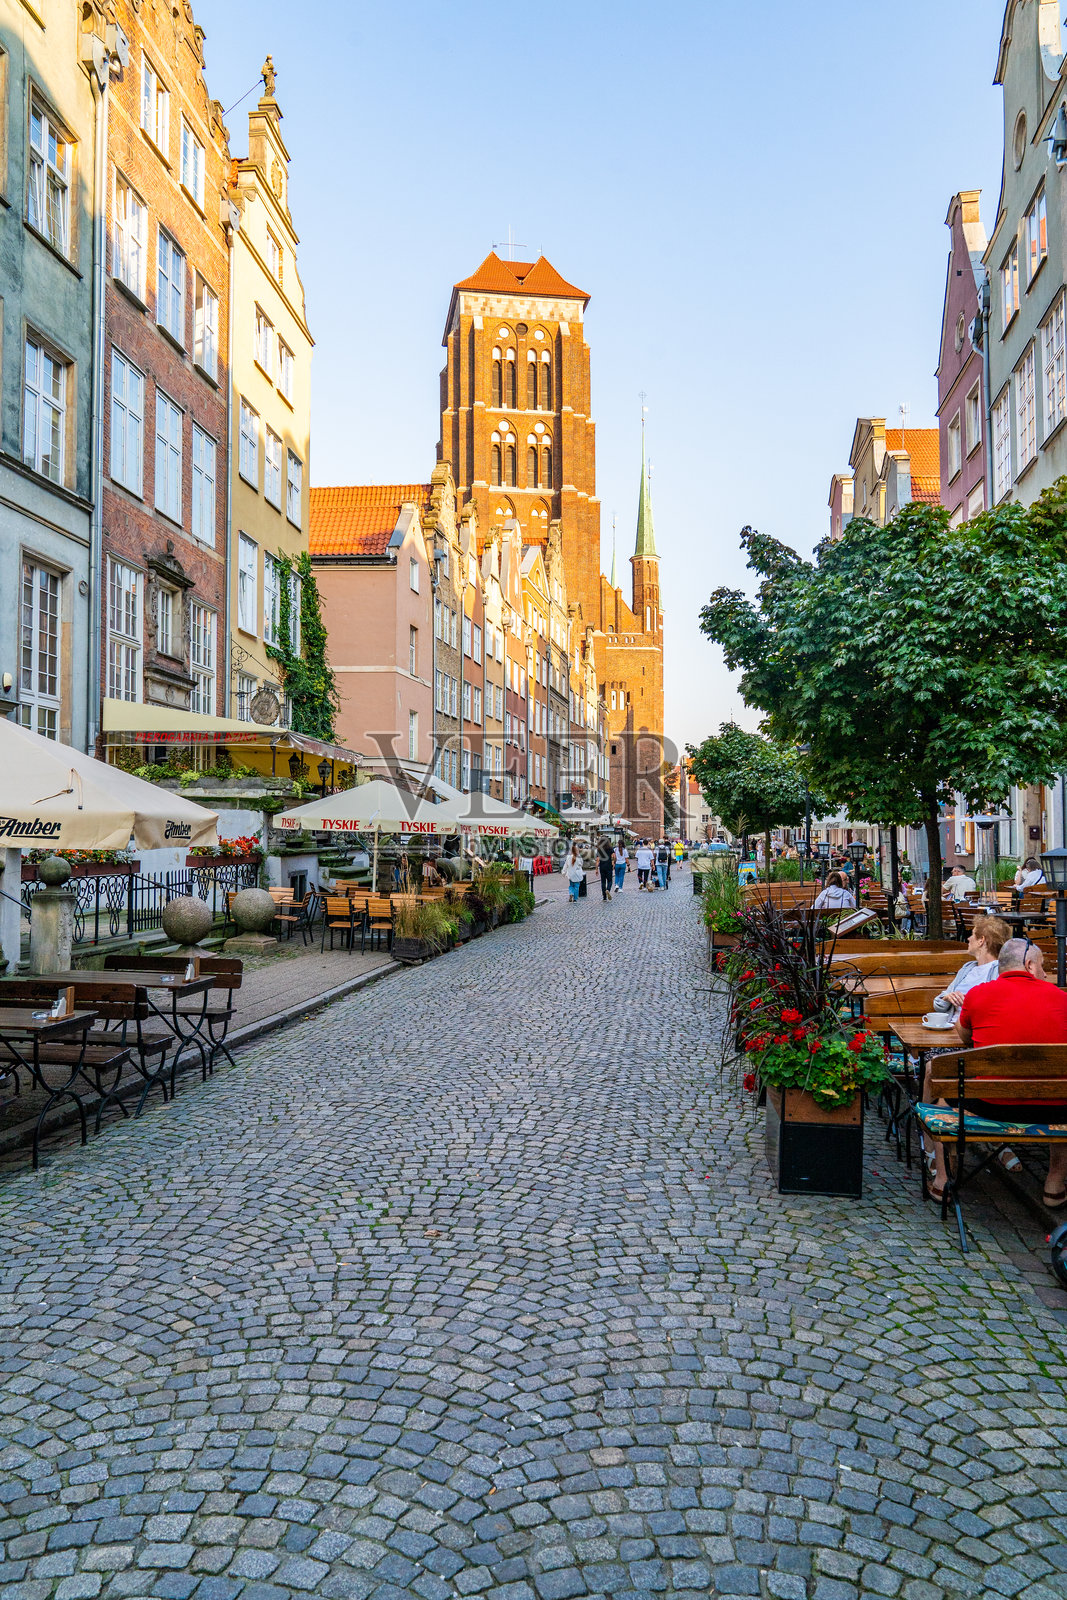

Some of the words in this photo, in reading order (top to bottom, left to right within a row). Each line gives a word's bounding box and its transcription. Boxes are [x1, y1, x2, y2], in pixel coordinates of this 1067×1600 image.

[135, 732, 209, 742] PIEROGARNIA
[224, 732, 257, 742] DZIKA
[0, 817, 62, 838] Amber
[165, 820, 192, 839] Amber
[321, 819, 360, 831] TYSKIE
[399, 821, 438, 833] TYSKIE
[478, 825, 510, 835] TYSKIE
